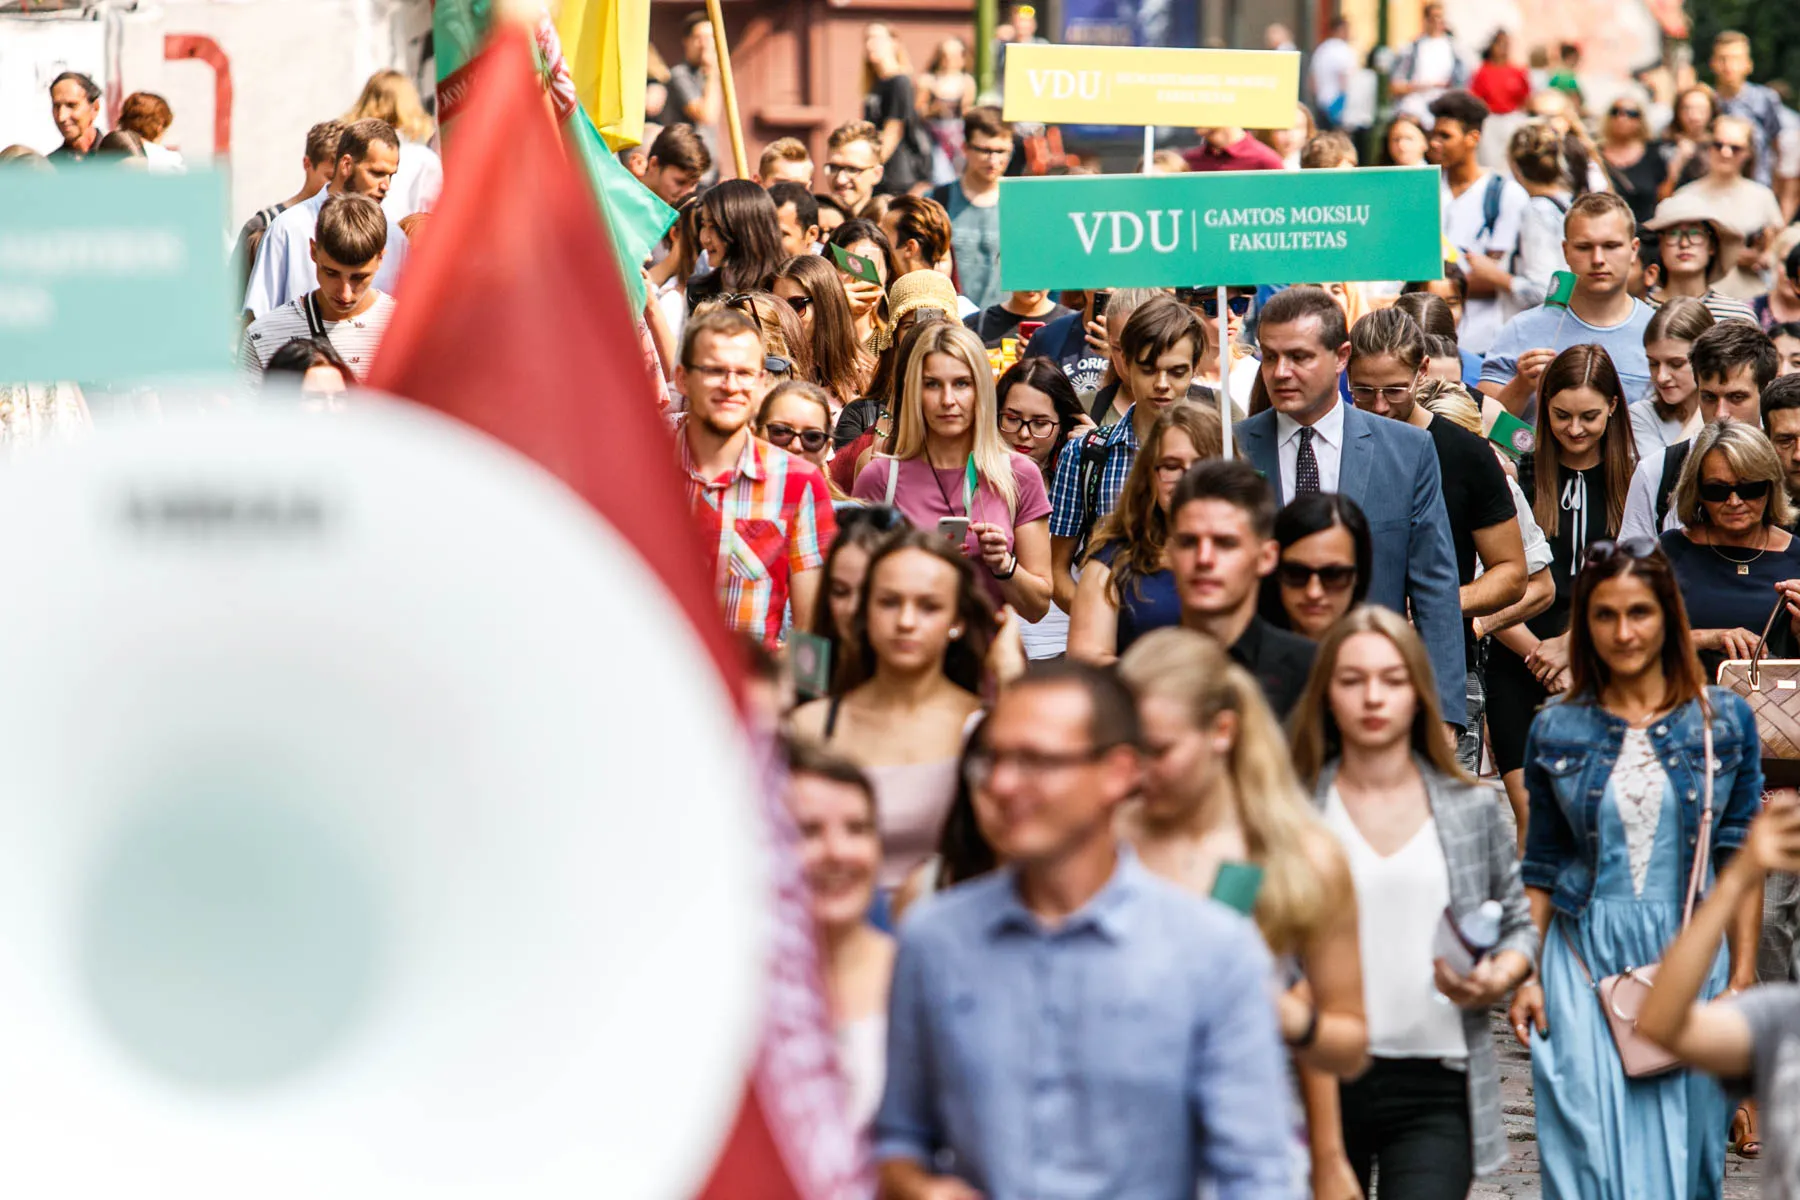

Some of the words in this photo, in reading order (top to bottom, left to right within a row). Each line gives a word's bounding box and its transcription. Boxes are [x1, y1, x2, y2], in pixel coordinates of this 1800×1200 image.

[1026, 69, 1102, 100] VDU
[1204, 207, 1286, 227] GAMTOS
[1290, 204, 1371, 226] MOKSLŲ
[1068, 209, 1184, 254] VDU
[1229, 230, 1347, 252] FAKULTETAS
